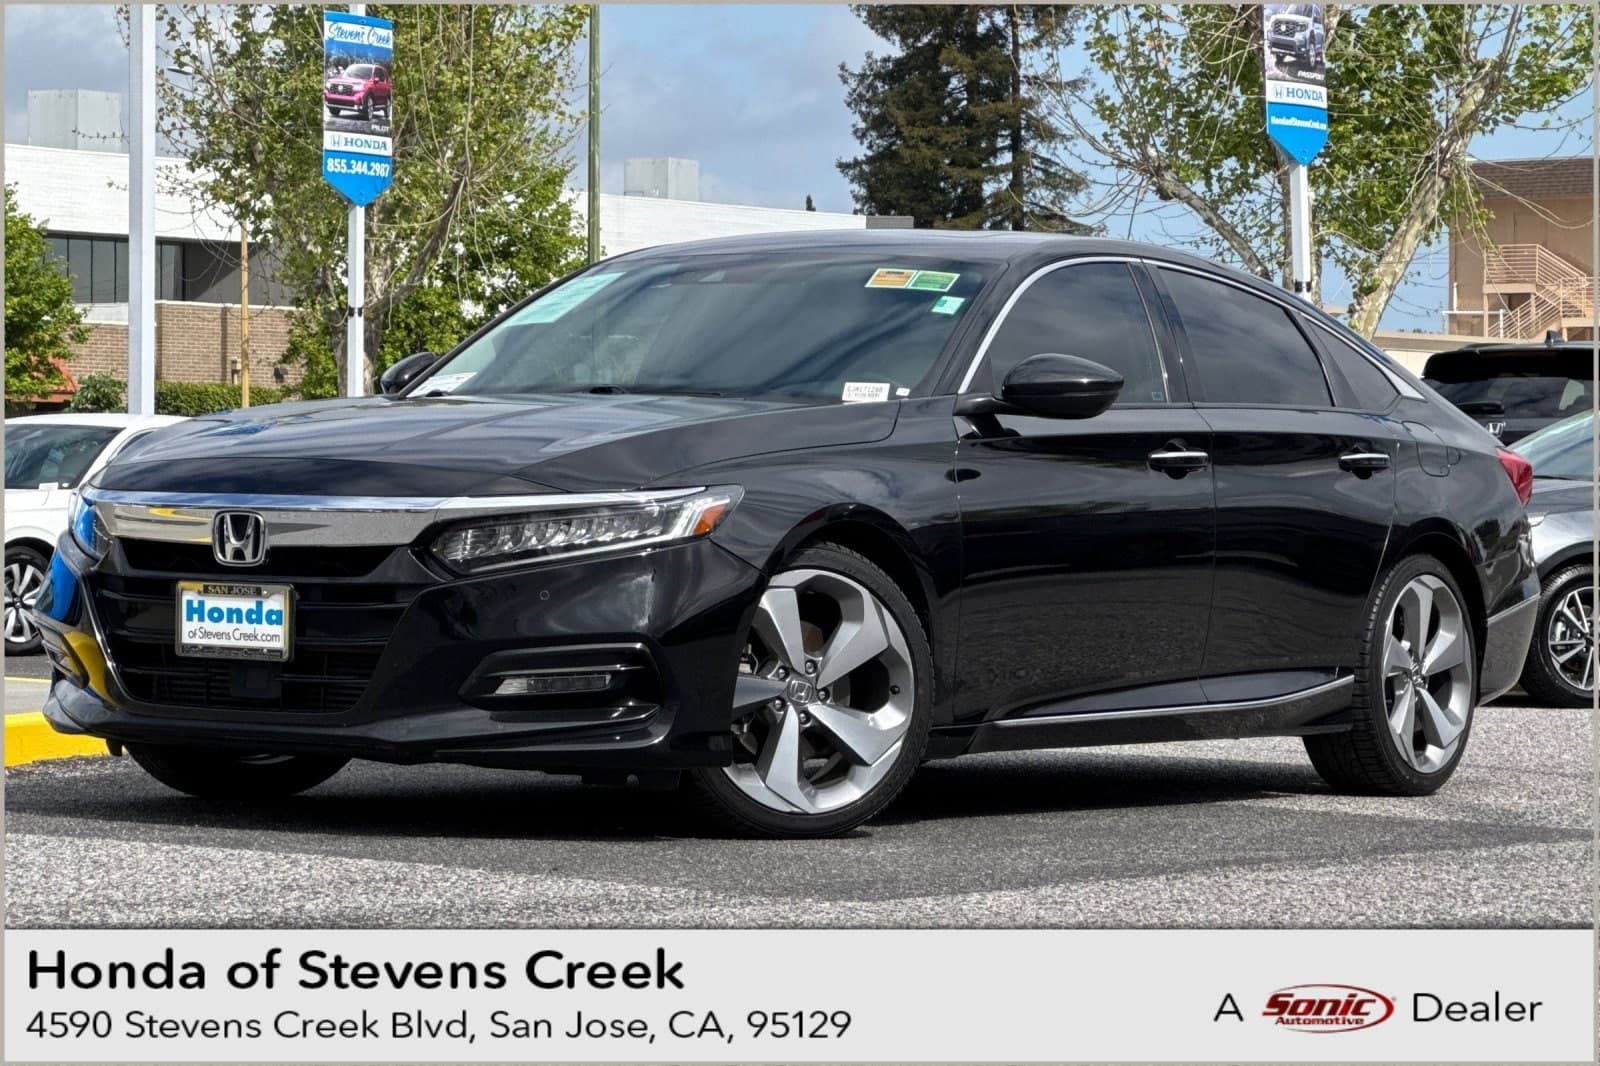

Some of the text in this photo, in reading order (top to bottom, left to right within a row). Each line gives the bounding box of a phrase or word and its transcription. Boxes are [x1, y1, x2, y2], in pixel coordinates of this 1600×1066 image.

[1286, 87, 1324, 102] HONDA
[344, 136, 388, 151] HONDA
[327, 157, 390, 178] 855.344.2987
[207, 585, 257, 596] SAN JOSE
[186, 599, 283, 626] Honda
[187, 626, 281, 643] of Stevens Creek.com
